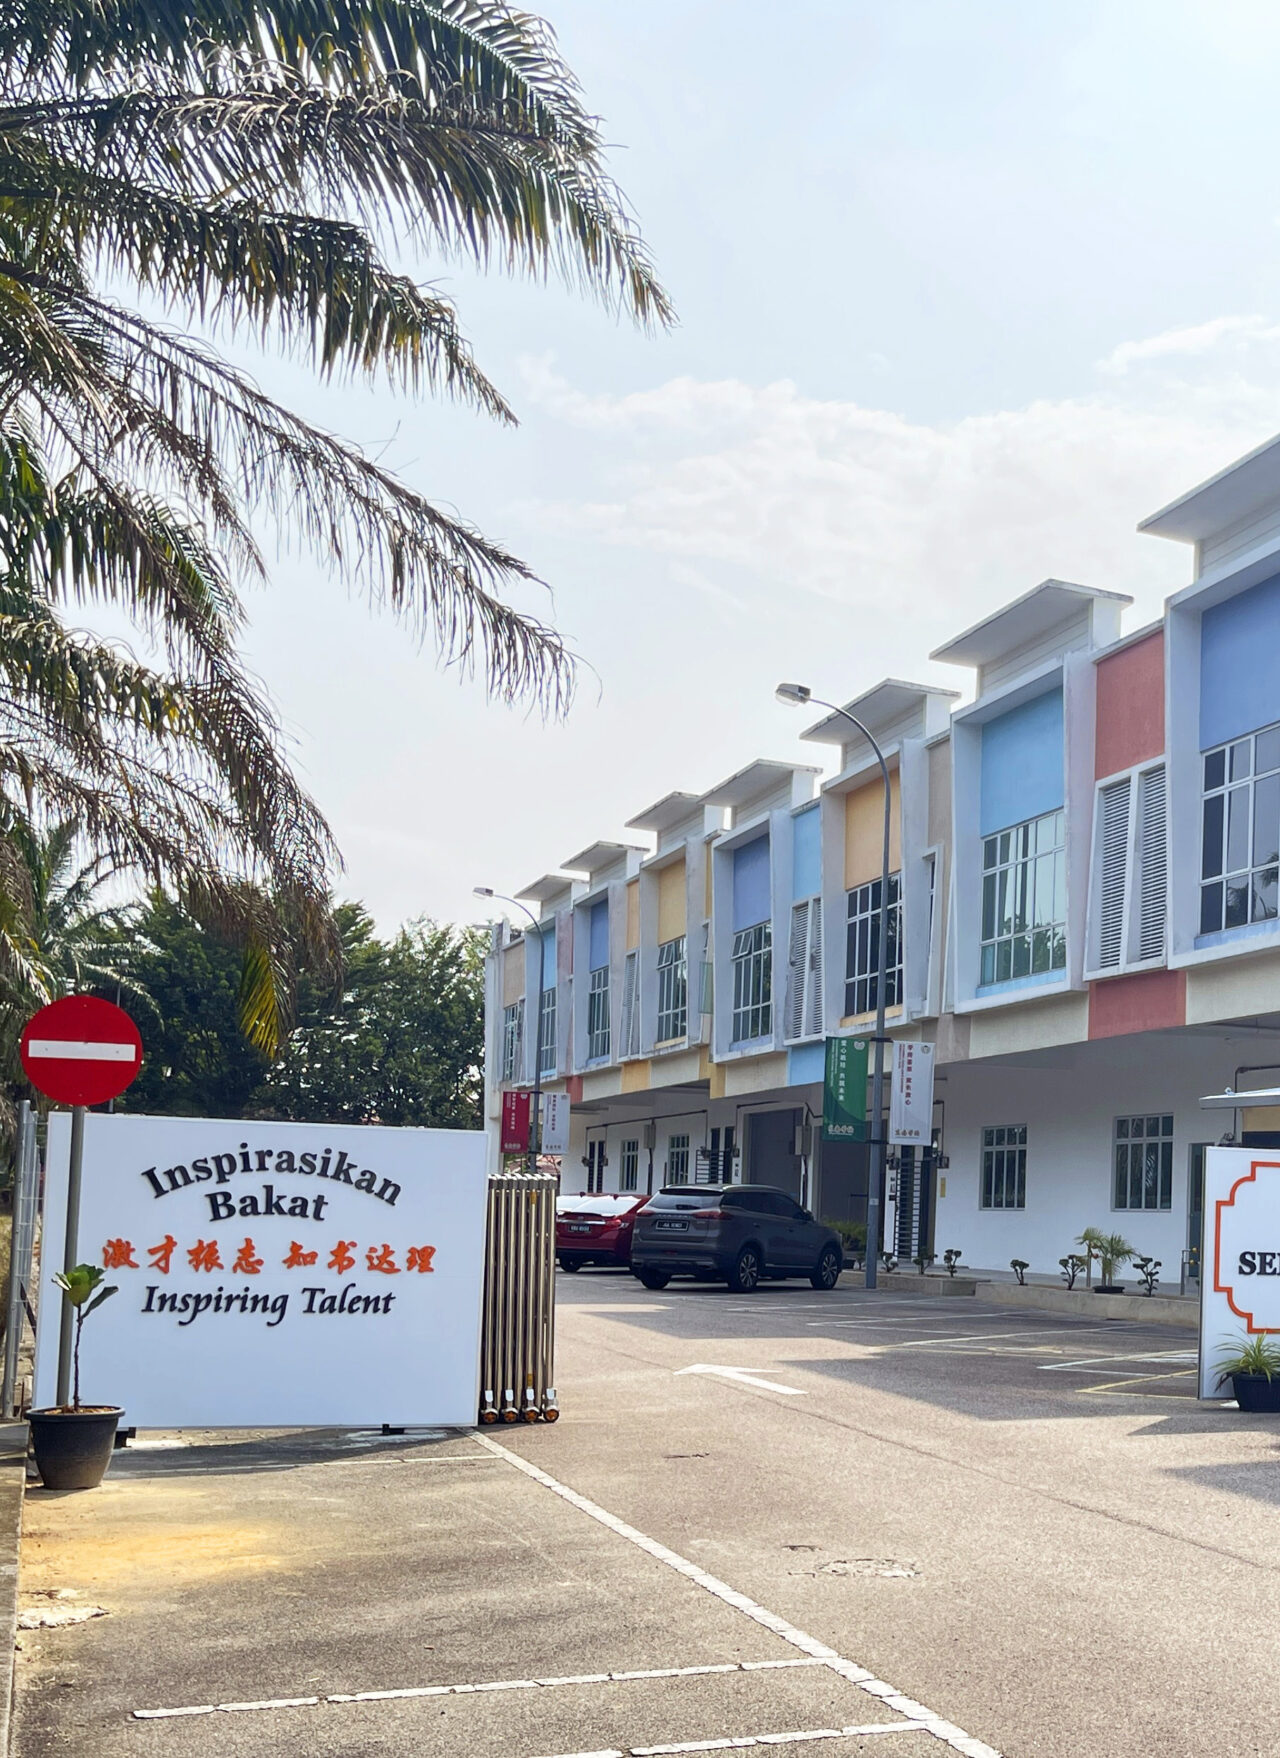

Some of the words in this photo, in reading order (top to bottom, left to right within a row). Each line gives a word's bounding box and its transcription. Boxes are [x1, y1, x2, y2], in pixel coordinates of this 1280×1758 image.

[141, 1142, 401, 1206] Inspirasikan
[205, 1185, 329, 1222] Bakat
[282, 1239, 436, 1275] 知书达理
[141, 1285, 290, 1327] Inspiring
[301, 1283, 397, 1315] Talent
